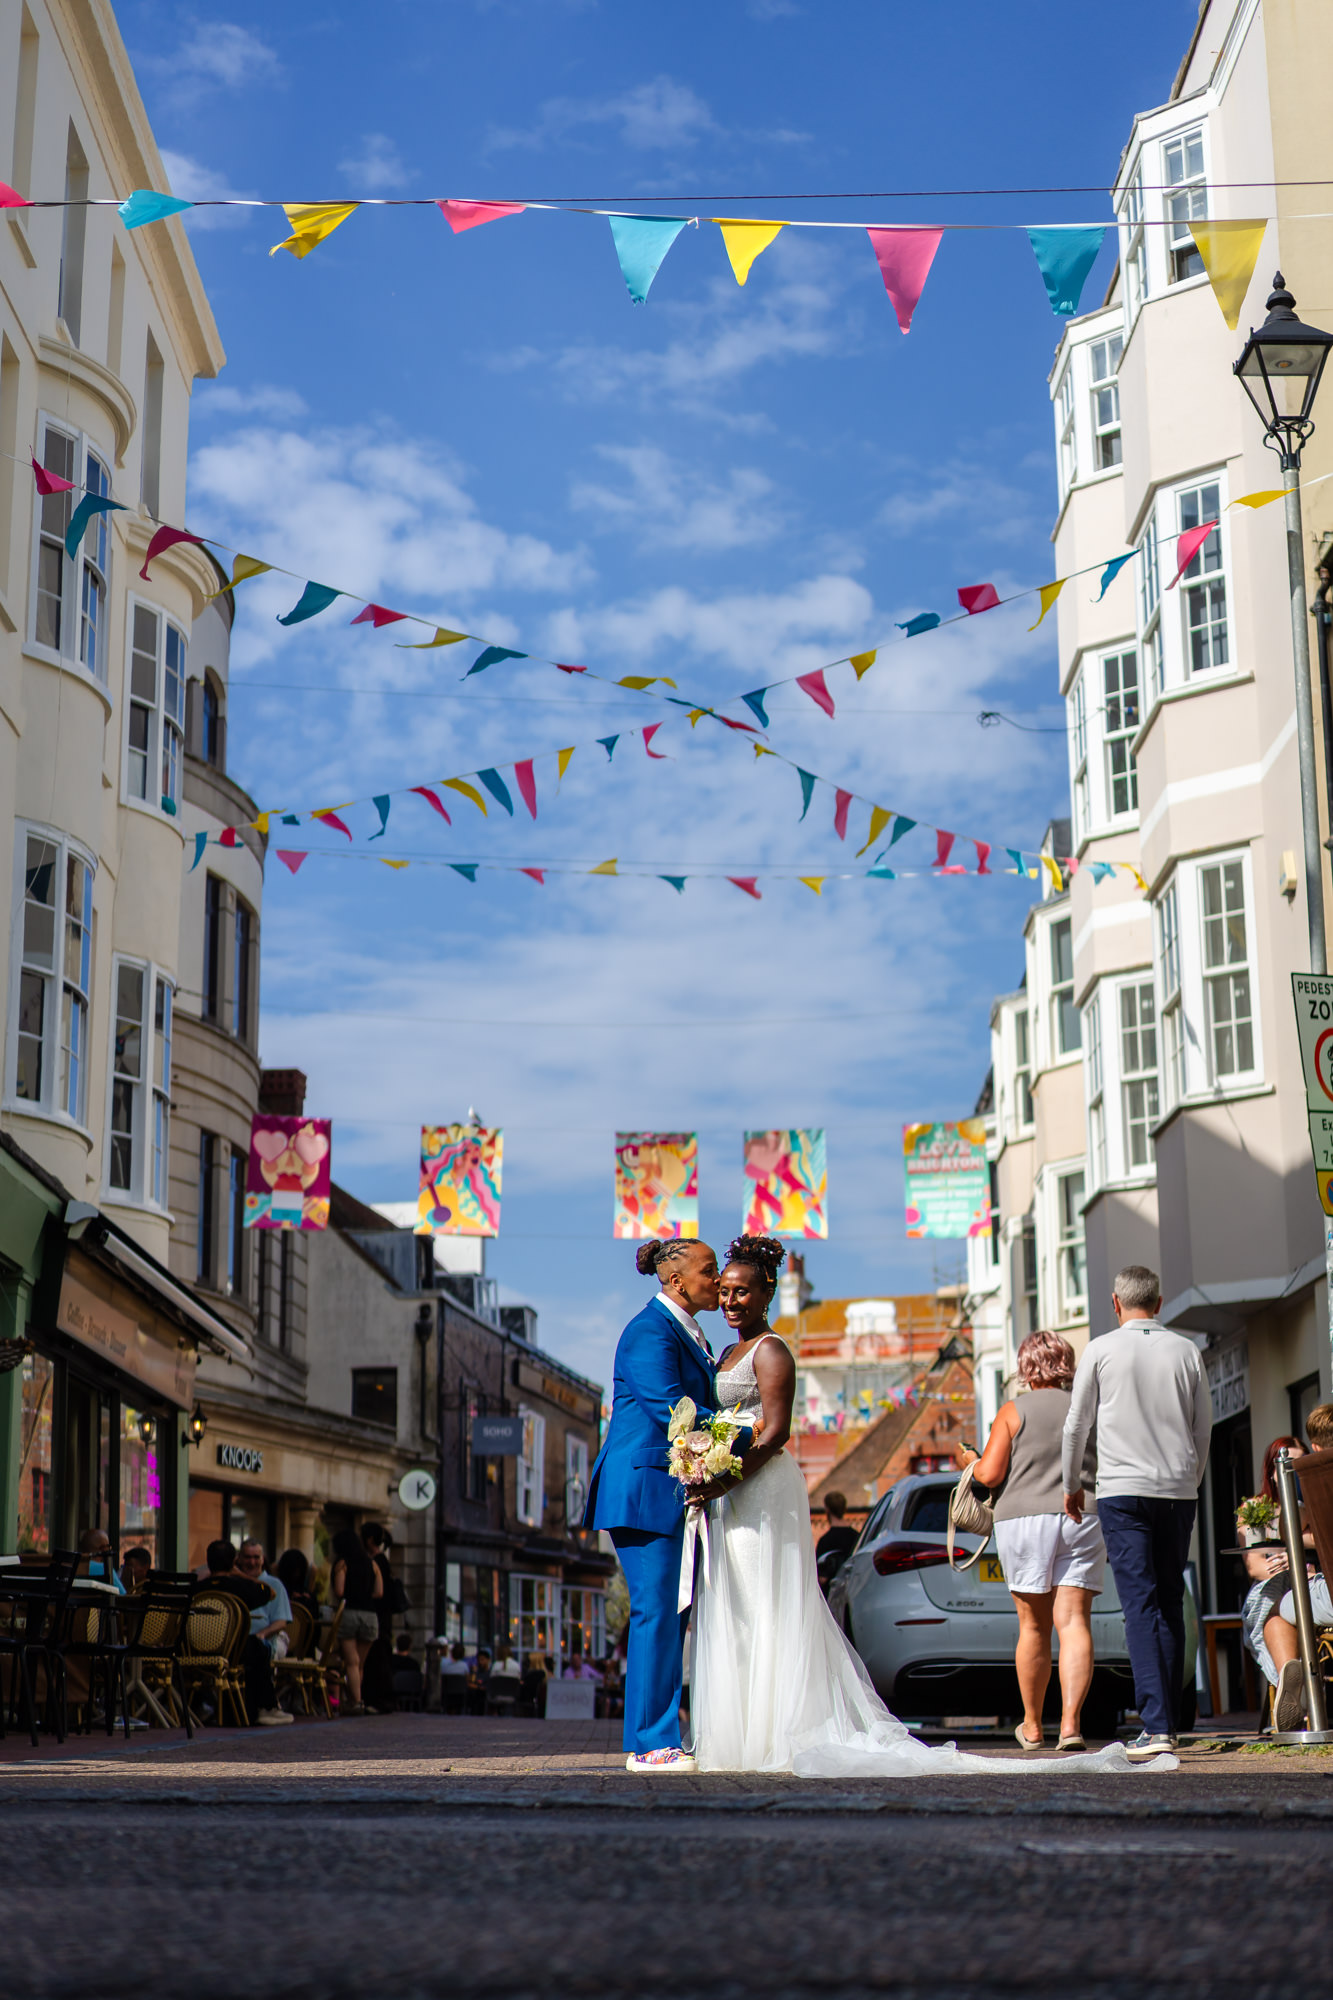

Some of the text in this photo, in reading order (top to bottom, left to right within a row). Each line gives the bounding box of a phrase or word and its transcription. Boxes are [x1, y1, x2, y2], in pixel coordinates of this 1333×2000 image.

[1308, 999, 1333, 1021] ZO
[919, 1141, 971, 1159] LOVE
[483, 1425, 513, 1438] SOHO
[221, 1444, 265, 1473] KNOOPS
[416, 1479, 430, 1500] K
